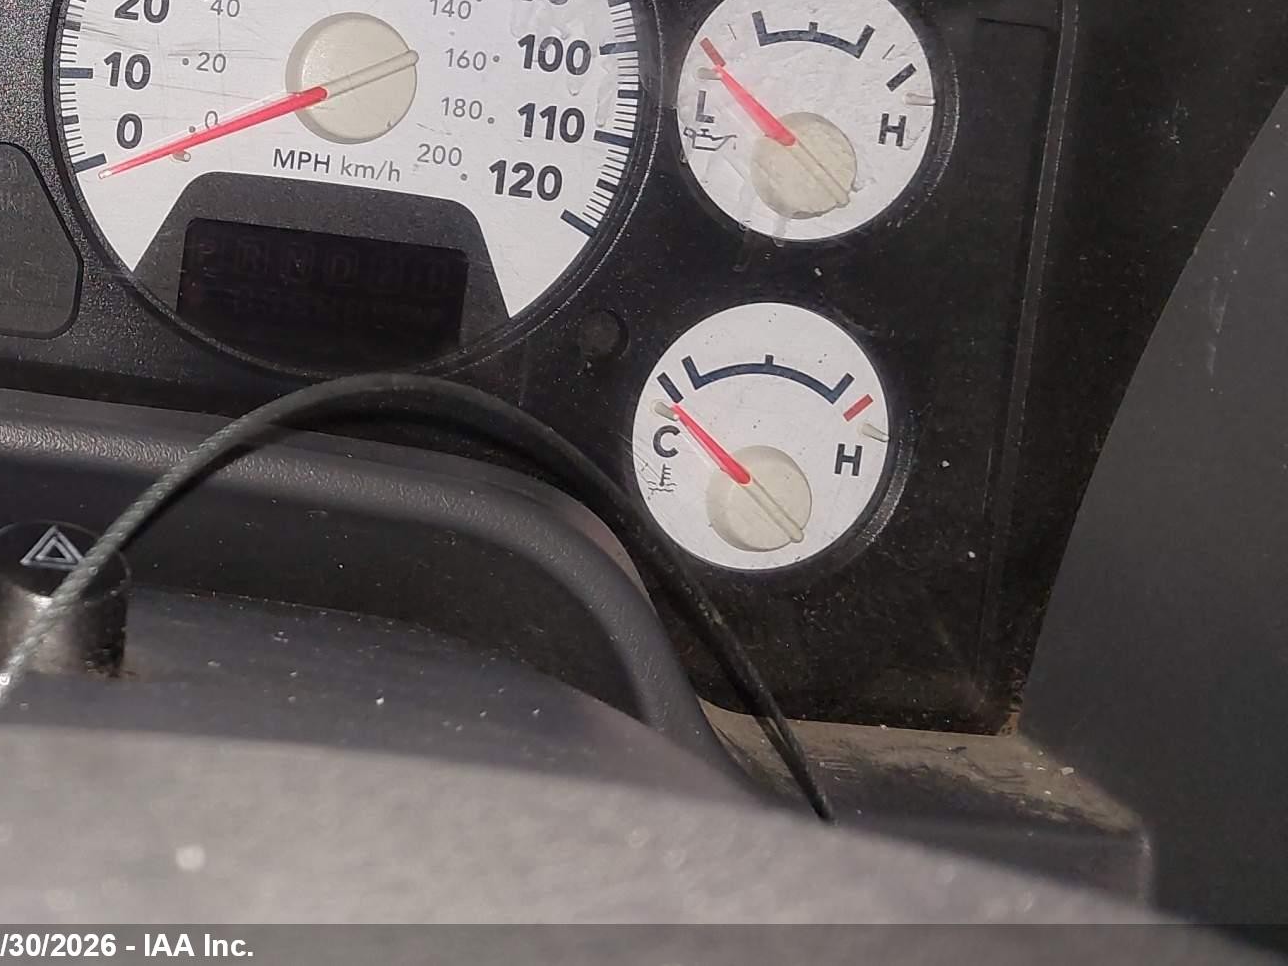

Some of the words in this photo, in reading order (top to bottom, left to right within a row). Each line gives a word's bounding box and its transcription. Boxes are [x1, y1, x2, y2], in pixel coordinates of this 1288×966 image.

[104, 51, 151, 90] 10
[196, 52, 226, 73] 20
[445, 48, 486, 71] 160
[517, 34, 591, 75] 100
[205, 110, 218, 130] 0
[441, 97, 483, 120] 180
[517, 103, 585, 142] 110
[696, 90, 714, 123] L
[116, 113, 143, 149] 0
[878, 113, 906, 147] H
[273, 148, 330, 173] MPH
[340, 160, 401, 182] km/h
[417, 143, 462, 166] 200
[488, 159, 563, 201] 120
[653, 425, 681, 458] C
[834, 443, 862, 476] H
